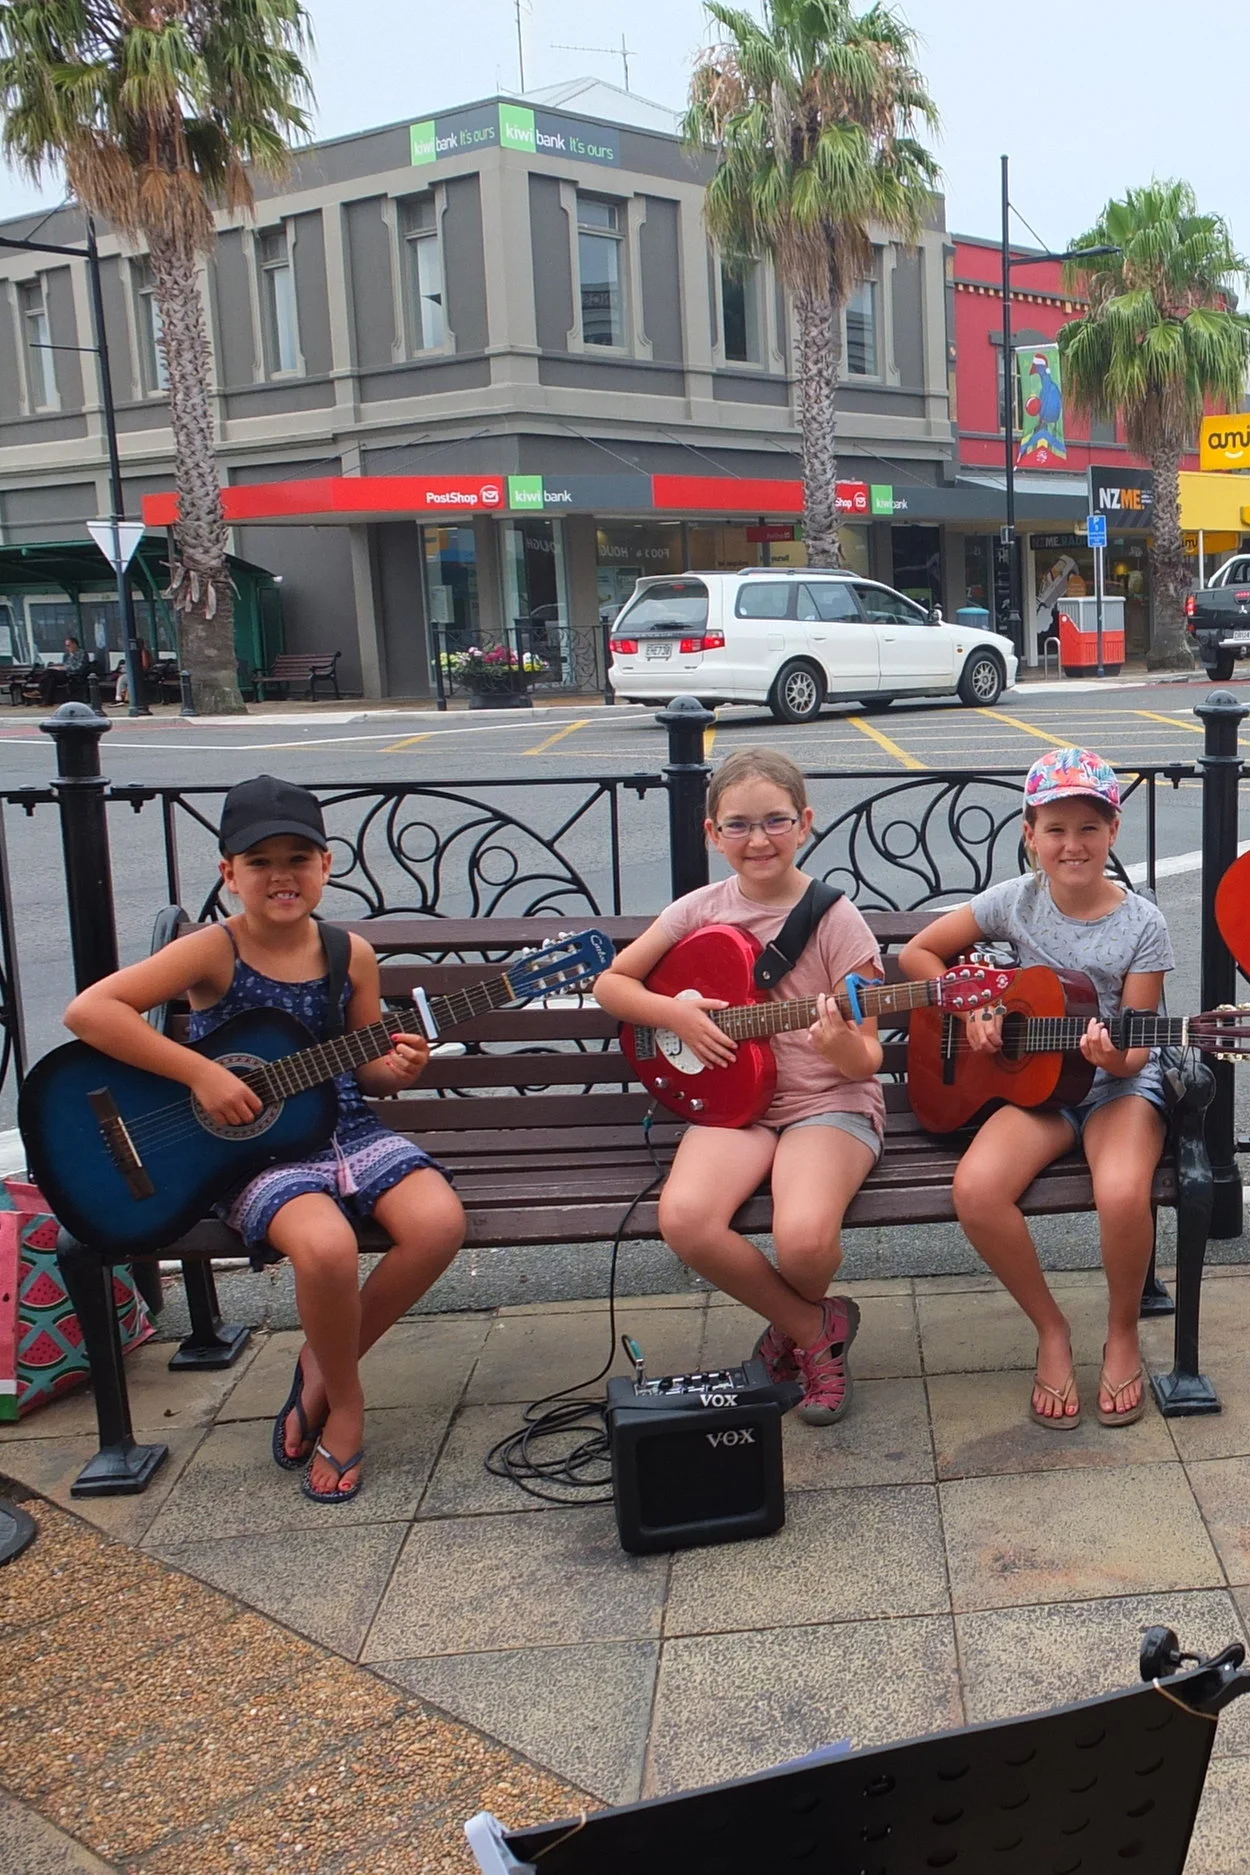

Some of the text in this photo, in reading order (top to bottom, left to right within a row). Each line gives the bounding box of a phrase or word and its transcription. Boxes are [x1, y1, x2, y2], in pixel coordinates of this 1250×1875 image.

[460, 130, 472, 145] It's
[473, 125, 495, 142] ours
[569, 137, 585, 154] It's
[587, 144, 614, 160] ours
[1208, 424, 1250, 450] ami
[426, 492, 478, 505] PostShop
[700, 1393, 738, 1408] VOX
[706, 1427, 756, 1449] VOX
